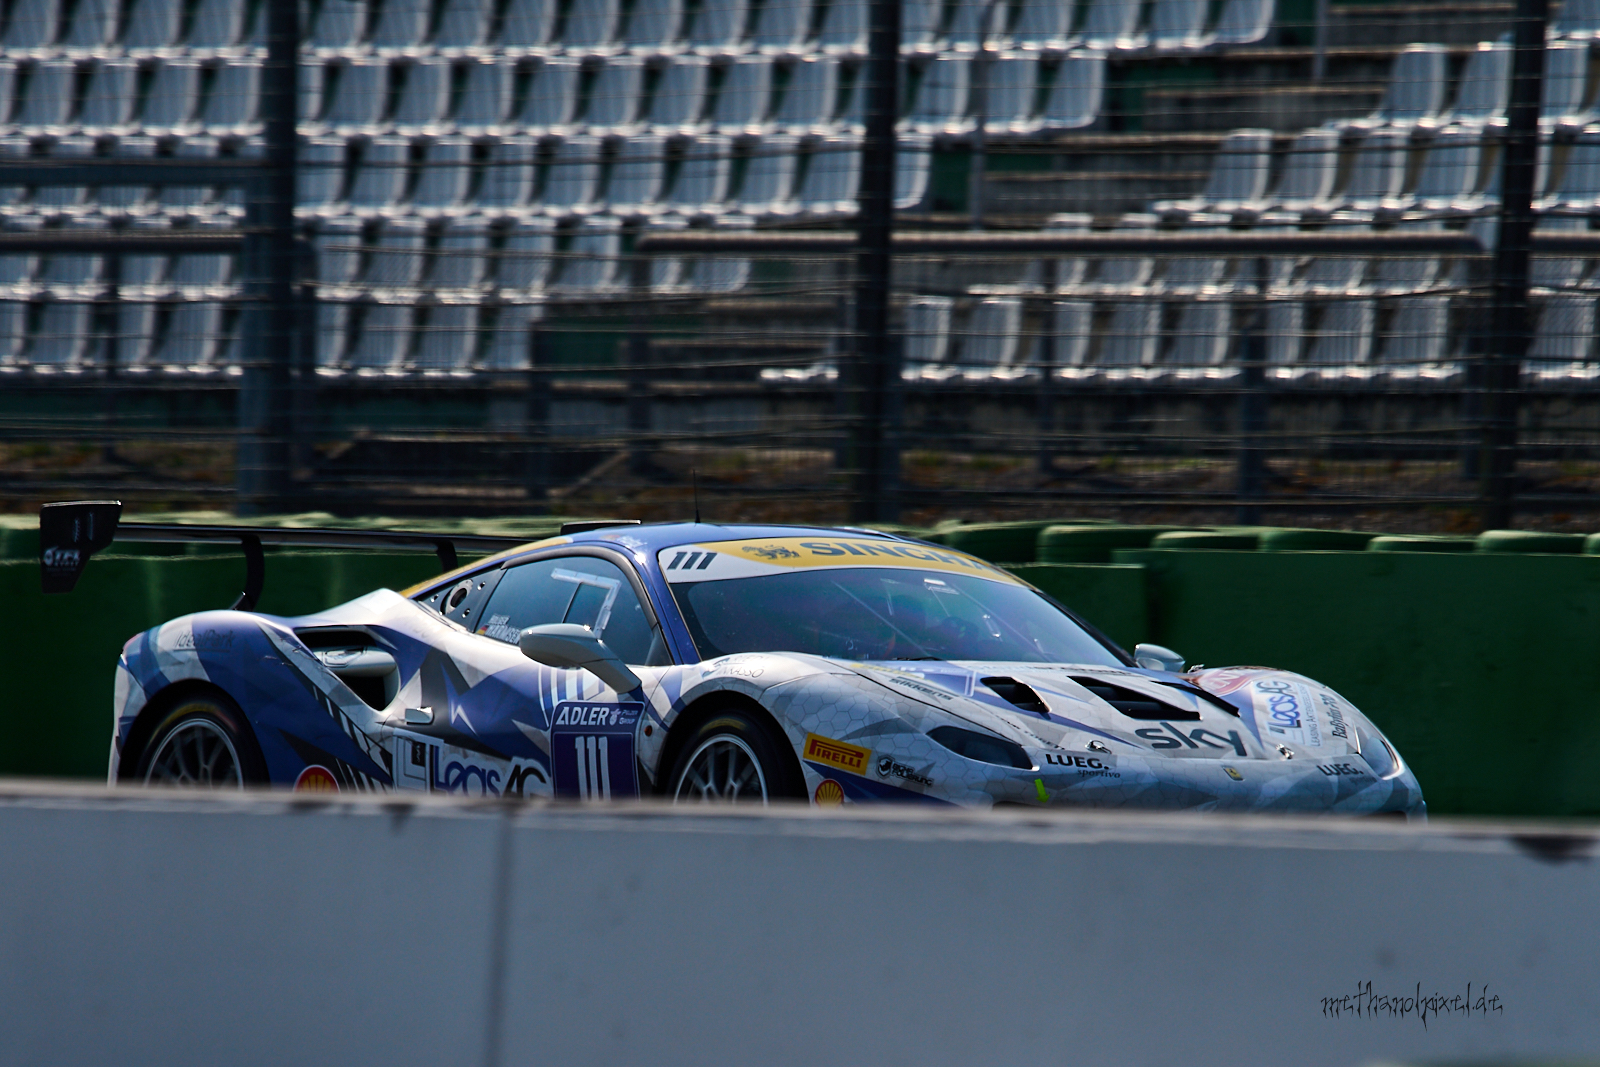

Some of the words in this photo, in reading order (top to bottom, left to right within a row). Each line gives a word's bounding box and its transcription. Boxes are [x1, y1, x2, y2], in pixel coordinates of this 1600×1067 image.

[667, 552, 718, 570] 111
[555, 706, 610, 726] ADLER
[1134, 721, 1248, 757] sky
[808, 738, 865, 768] PIRELLI
[1045, 753, 1109, 770] LUEG.
[575, 735, 611, 801] 111
[1078, 769, 1121, 779] sportivo
